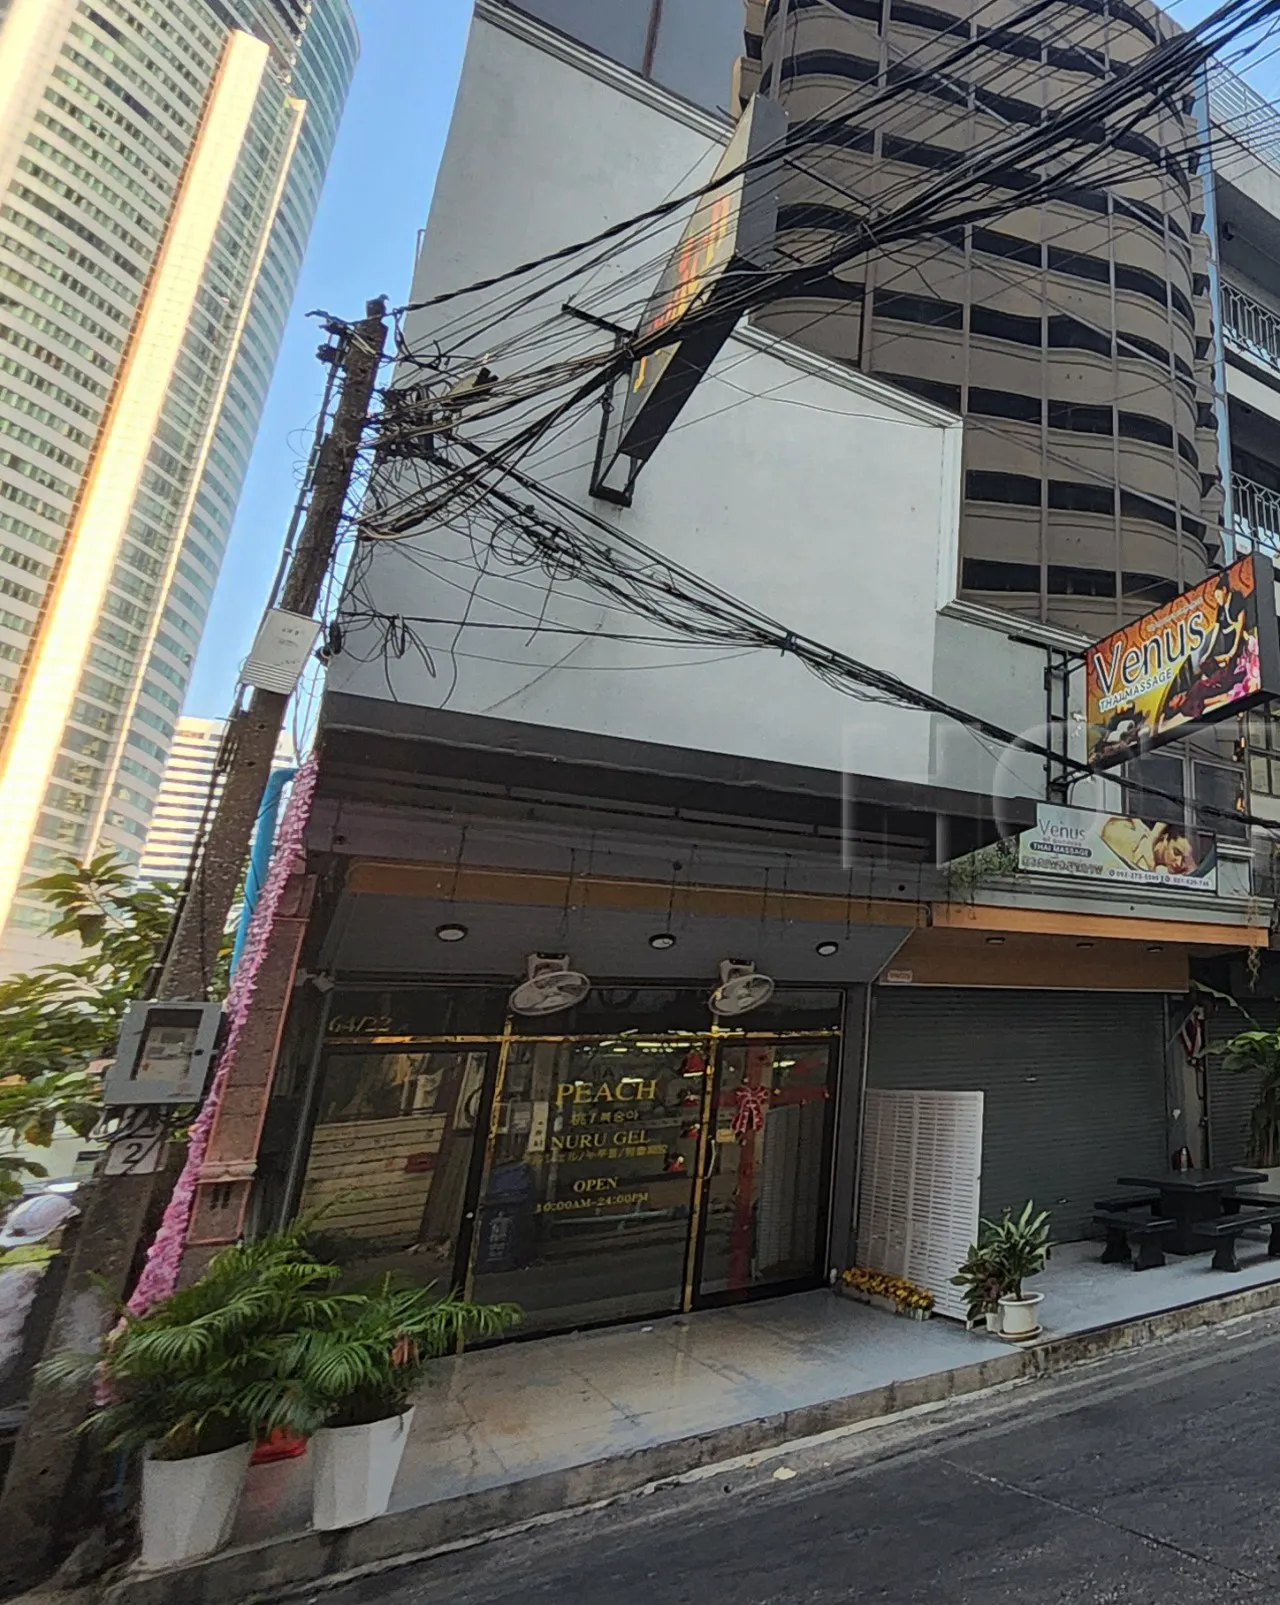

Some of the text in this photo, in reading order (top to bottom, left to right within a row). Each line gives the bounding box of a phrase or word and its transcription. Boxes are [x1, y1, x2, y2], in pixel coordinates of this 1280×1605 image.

[1094, 611, 1206, 697] Venus
[1099, 668, 1173, 713] THAI MASSAGE
[1038, 818, 1088, 841] Venus
[1032, 842, 1090, 857] THAI MASSAGE
[555, 1079, 658, 1106] PEACH
[551, 1132, 608, 1150] NURU
[613, 1130, 651, 1146] GEL
[573, 1177, 620, 1194] OPEN
